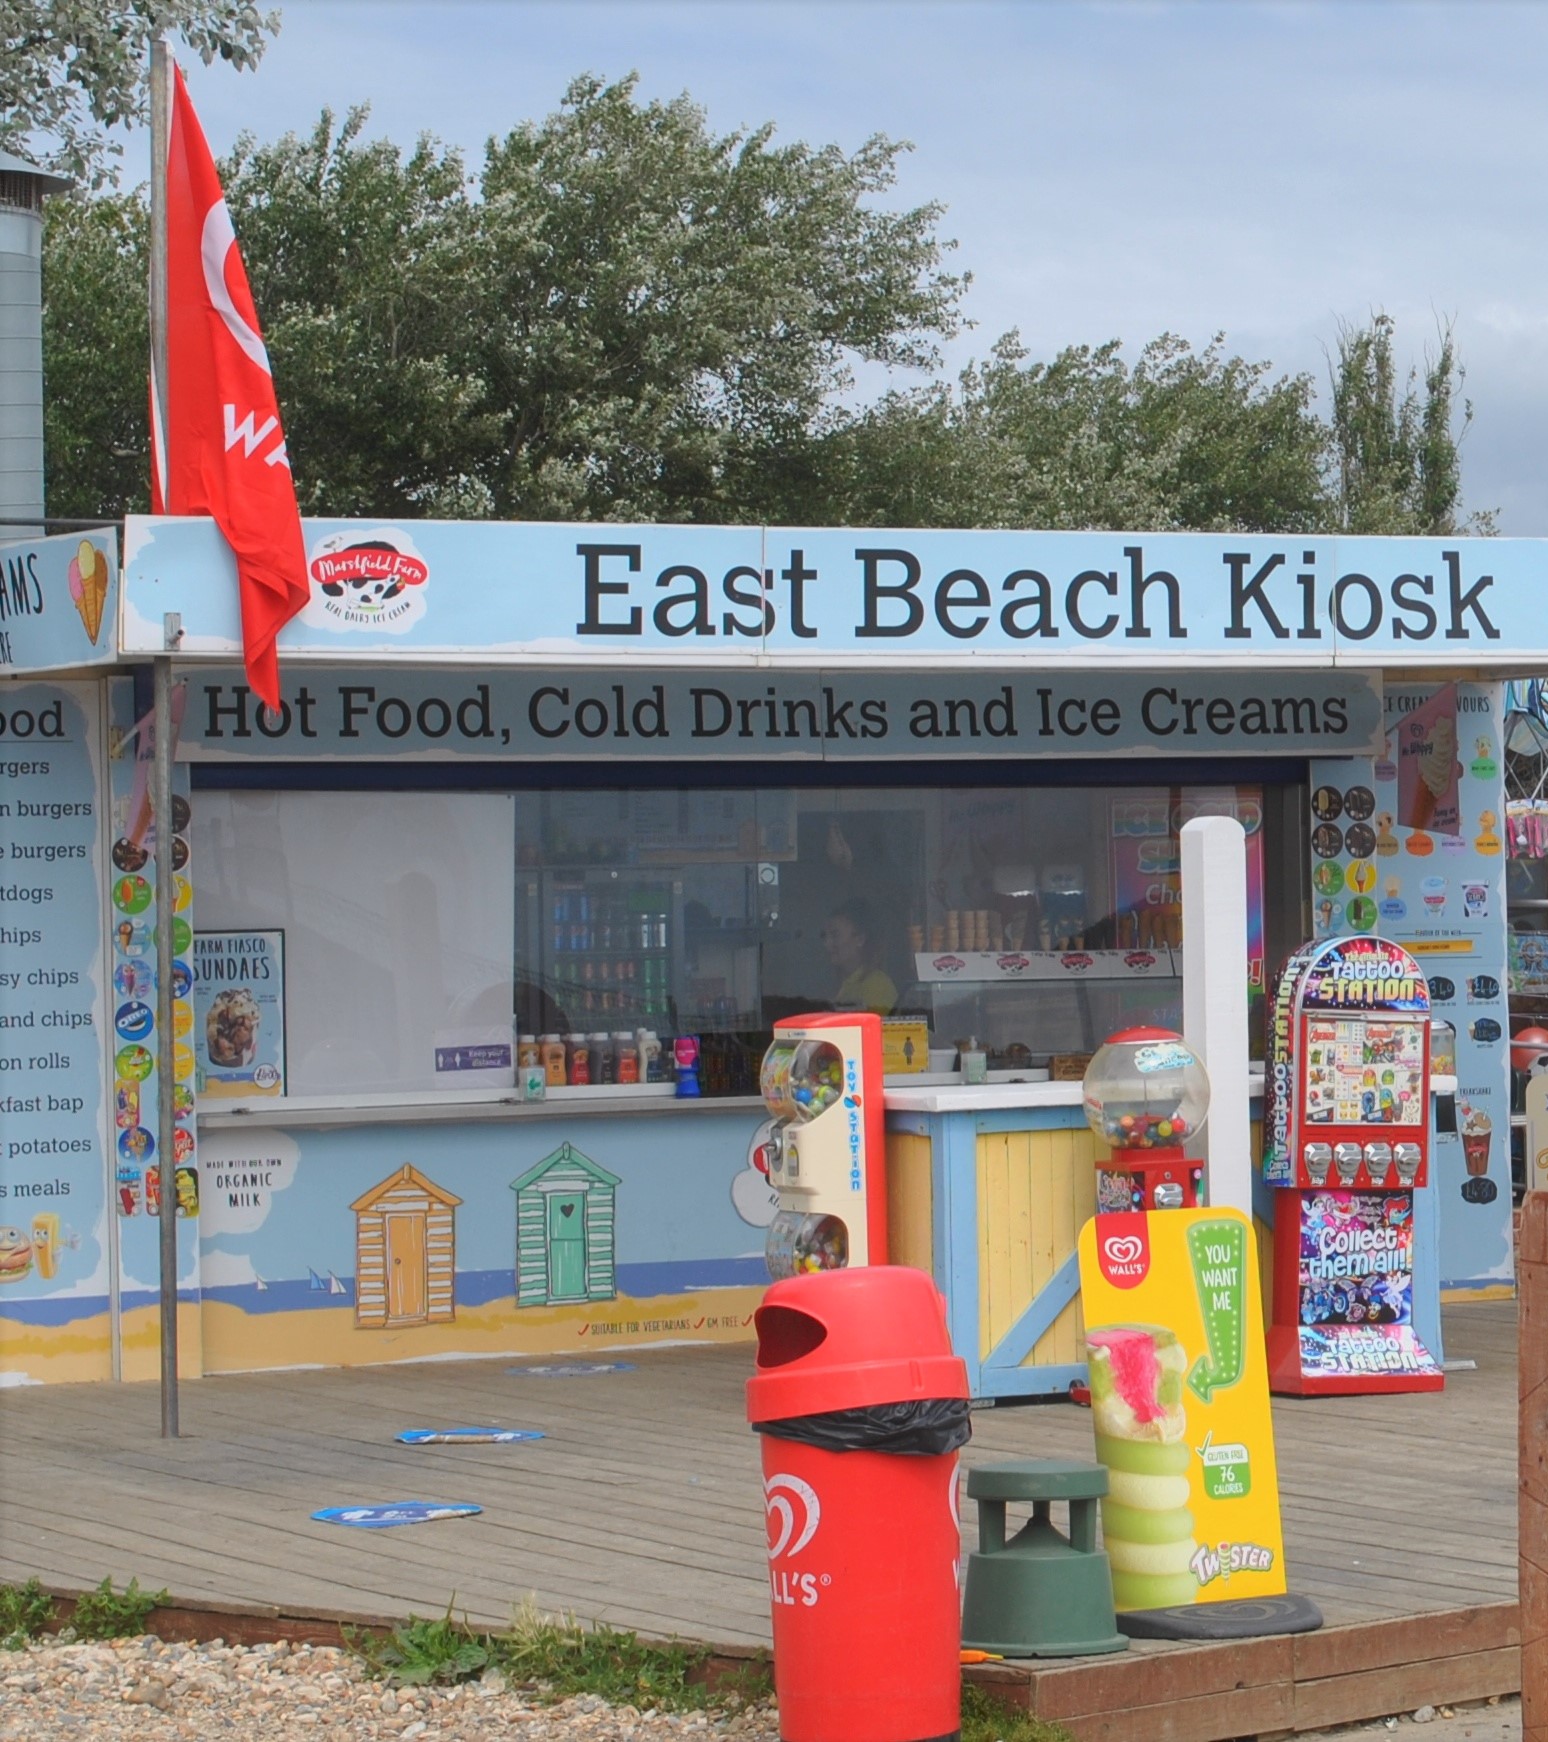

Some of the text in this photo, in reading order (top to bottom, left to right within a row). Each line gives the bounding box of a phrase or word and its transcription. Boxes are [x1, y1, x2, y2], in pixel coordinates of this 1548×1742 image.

[319, 554, 422, 581] Marshfield Farm
[576, 543, 1500, 641] East Beach Kiosk
[325, 601, 411, 623] REAL DAIRY ICE CREAM
[204, 684, 1348, 745] Hot Food, Cold Drinks and Ice Creams
[17, 800, 92, 819] burgers
[11, 843, 86, 861] burgers
[193, 937, 266, 954] FARM FIASCO
[27, 968, 79, 987] chips
[193, 956, 270, 981] SUNDAES
[1331, 961, 1404, 980] Tattoo
[1319, 978, 1414, 1005] STATION
[41, 1010, 93, 1029] chips
[28, 1052, 70, 1070] rolls
[468, 1049, 487, 1060] Keep
[48, 1095, 84, 1115] bap
[9, 1138, 92, 1158] potatoes
[206, 1162, 224, 1170] MADE
[248, 1160, 263, 1168] OUR
[266, 1159, 282, 1167] OWN
[14, 1179, 71, 1197] meals
[216, 1172, 273, 1189] ORGANIC
[229, 1193, 261, 1209] MILK
[1319, 1227, 1398, 1253] Collect
[1205, 1244, 1231, 1265] YOU
[1309, 1247, 1407, 1279] them all!
[1108, 1263, 1143, 1275] WALL'S
[1202, 1267, 1238, 1288] WANT
[1213, 1291, 1232, 1311] ME
[591, 1316, 739, 1336] SUITABLE FOR VEGETARIANS GM FREE
[1328, 1338, 1399, 1354] Tattoo
[1207, 1449, 1244, 1462] GLUTEN FREE
[1220, 1466, 1236, 1482] 76
[1213, 1482, 1244, 1495] CALORIES
[1190, 1543, 1273, 1586] TWISTER
